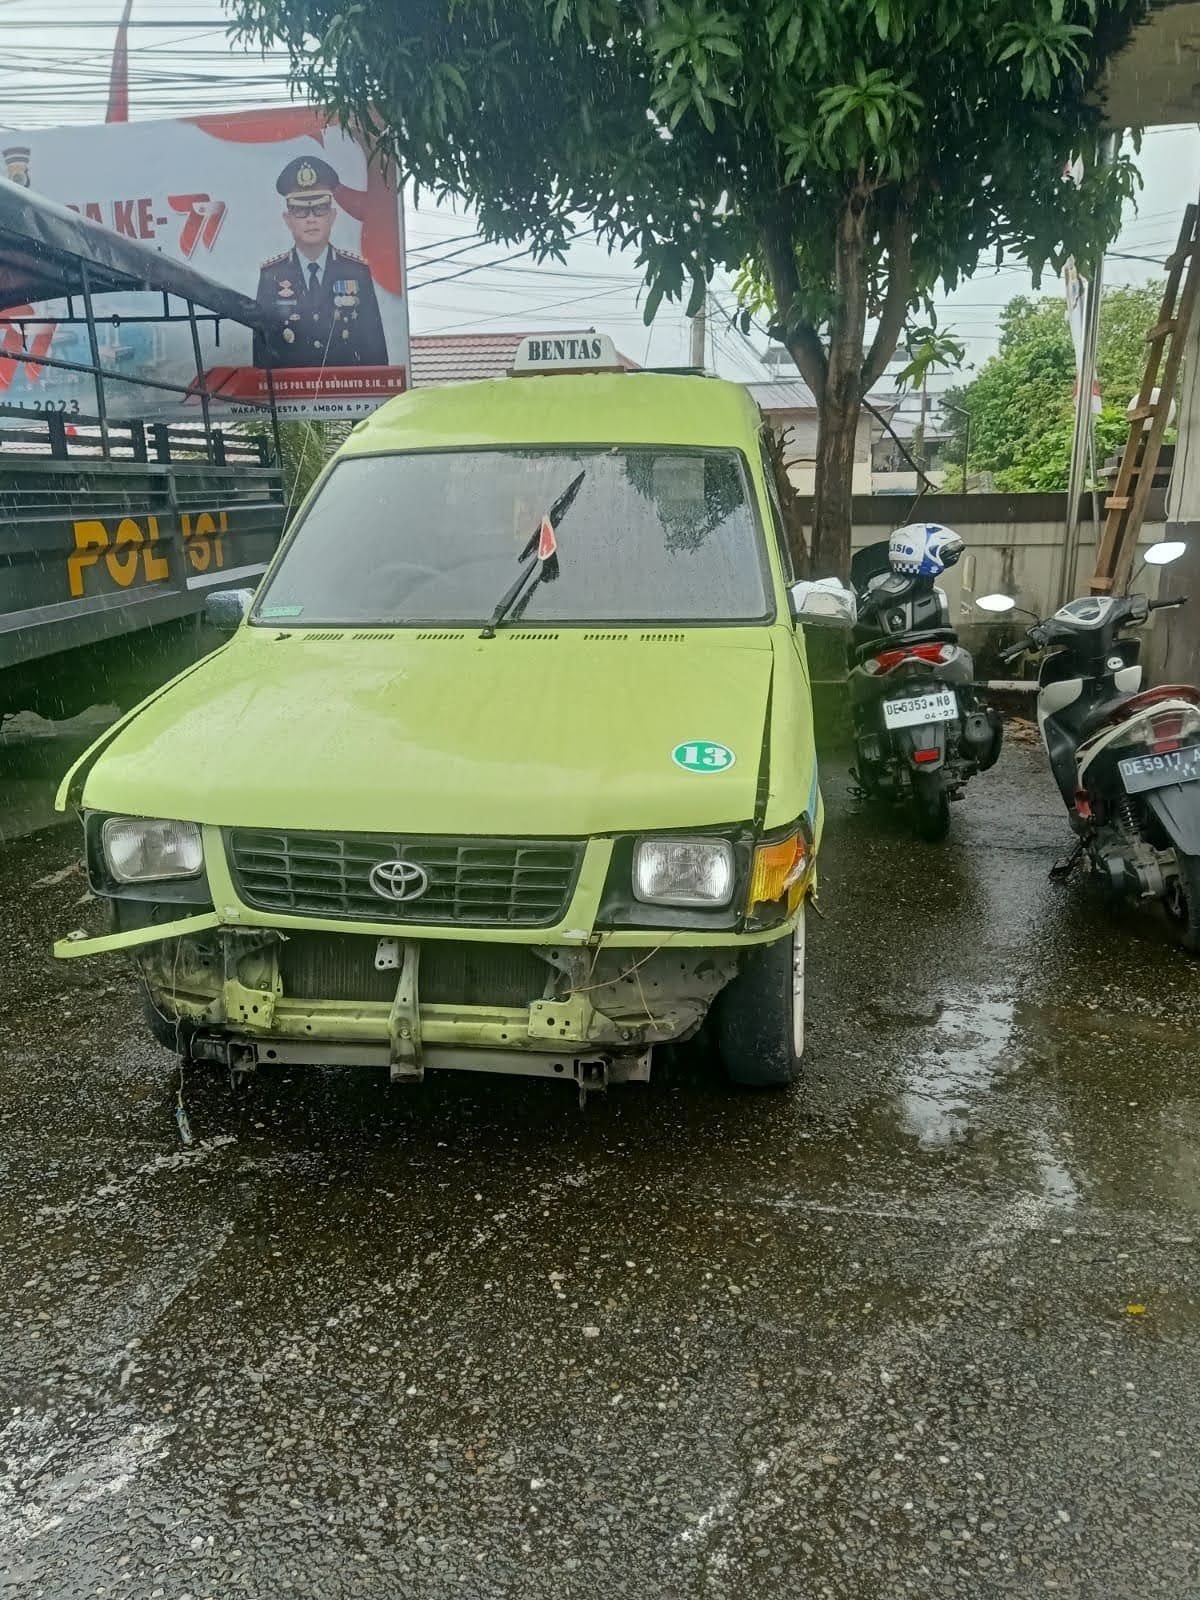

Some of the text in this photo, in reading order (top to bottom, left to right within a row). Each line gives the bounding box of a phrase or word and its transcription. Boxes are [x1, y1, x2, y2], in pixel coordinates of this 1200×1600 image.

[527, 338, 602, 361] BENTAS
[33, 399, 80, 415] 2023
[313, 404, 343, 412] AMBON
[67, 511, 229, 597] POLISI
[681, 746, 728, 766] 13
